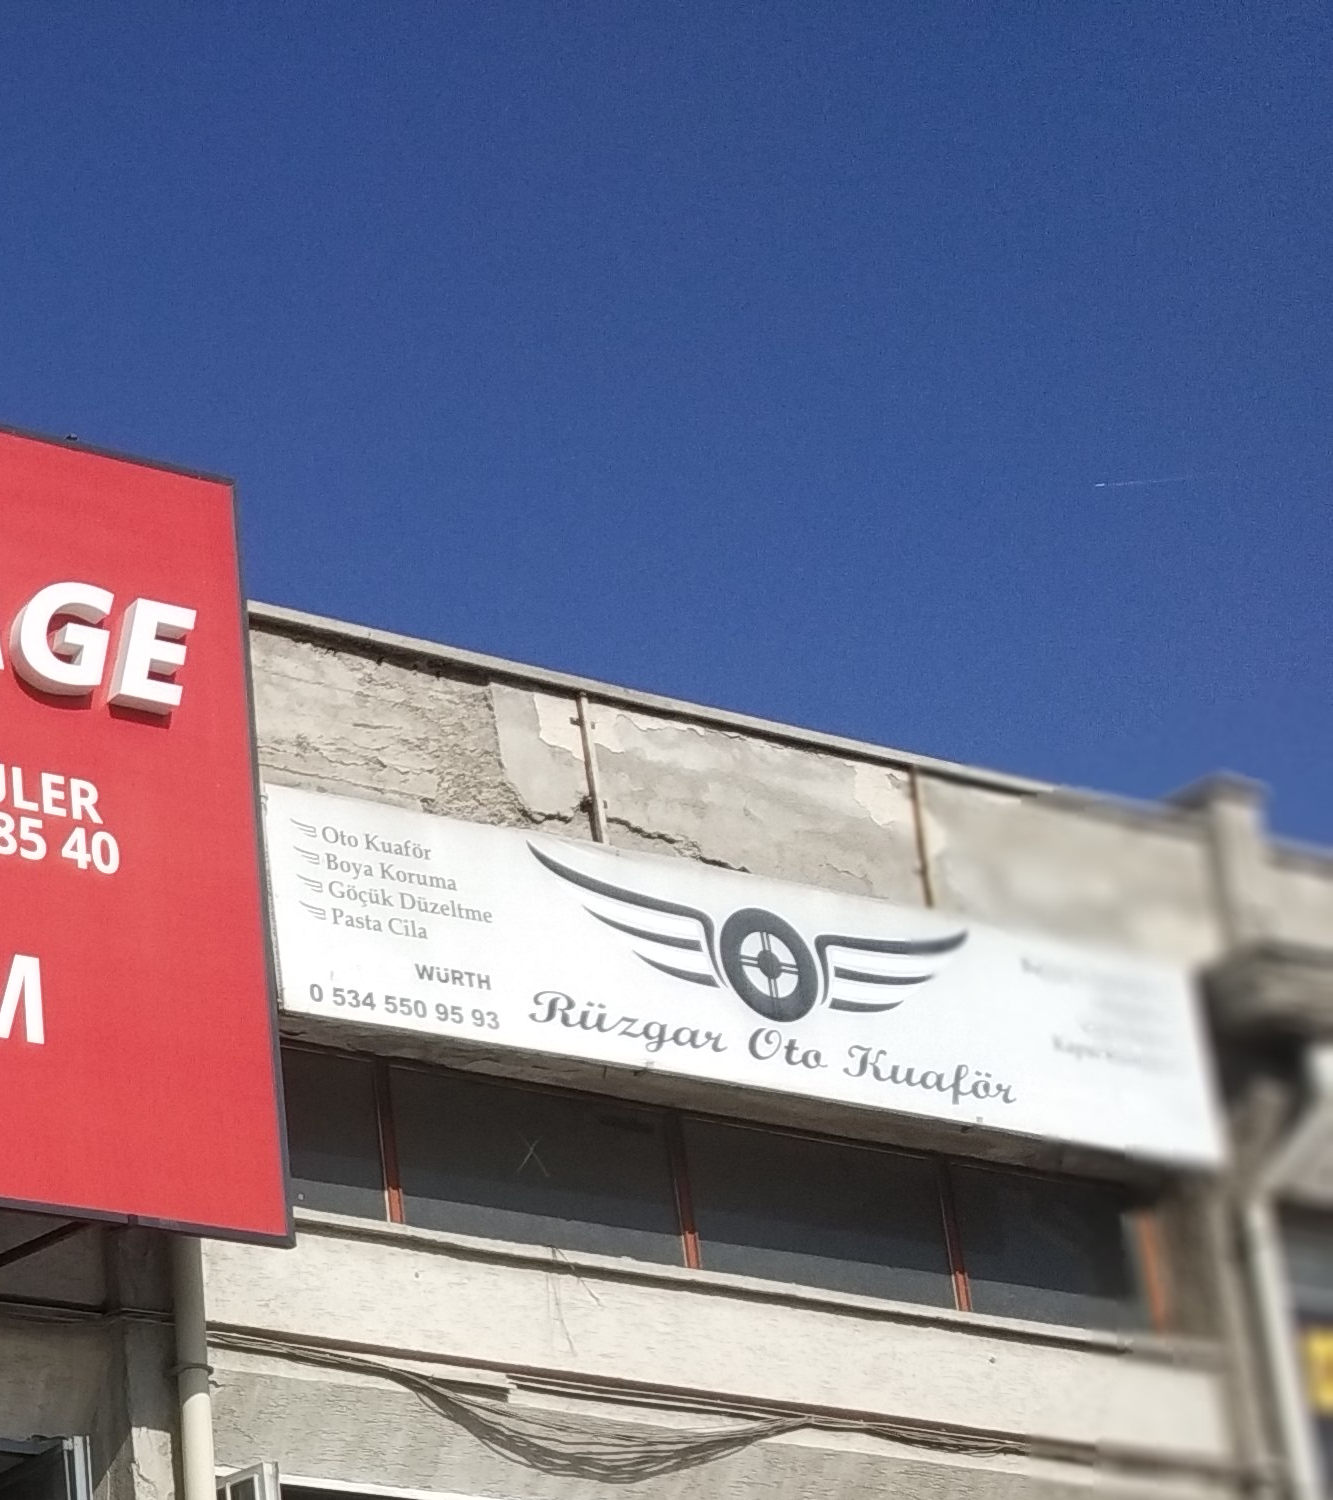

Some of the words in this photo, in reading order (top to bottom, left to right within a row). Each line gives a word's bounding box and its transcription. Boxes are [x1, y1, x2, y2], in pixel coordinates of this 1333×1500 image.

[60, 826, 120, 875] 40
[321, 825, 359, 849] Oto
[364, 830, 433, 862] Kuaför
[325, 852, 375, 880] Boya
[379, 861, 458, 892] Koruma
[328, 879, 394, 909] Göçük
[399, 891, 494, 925] Düzeltme
[331, 905, 386, 935] Pasta
[388, 914, 429, 942] Cila
[308, 982, 324, 1004] 0
[331, 987, 377, 1012] 534
[383, 994, 428, 1020] 550
[434, 1001, 465, 1026] 95
[471, 1006, 502, 1031] 93
[527, 989, 730, 1055] Rüzgar
[748, 1026, 829, 1070] Oto
[841, 1043, 1019, 1106] Kuaför
